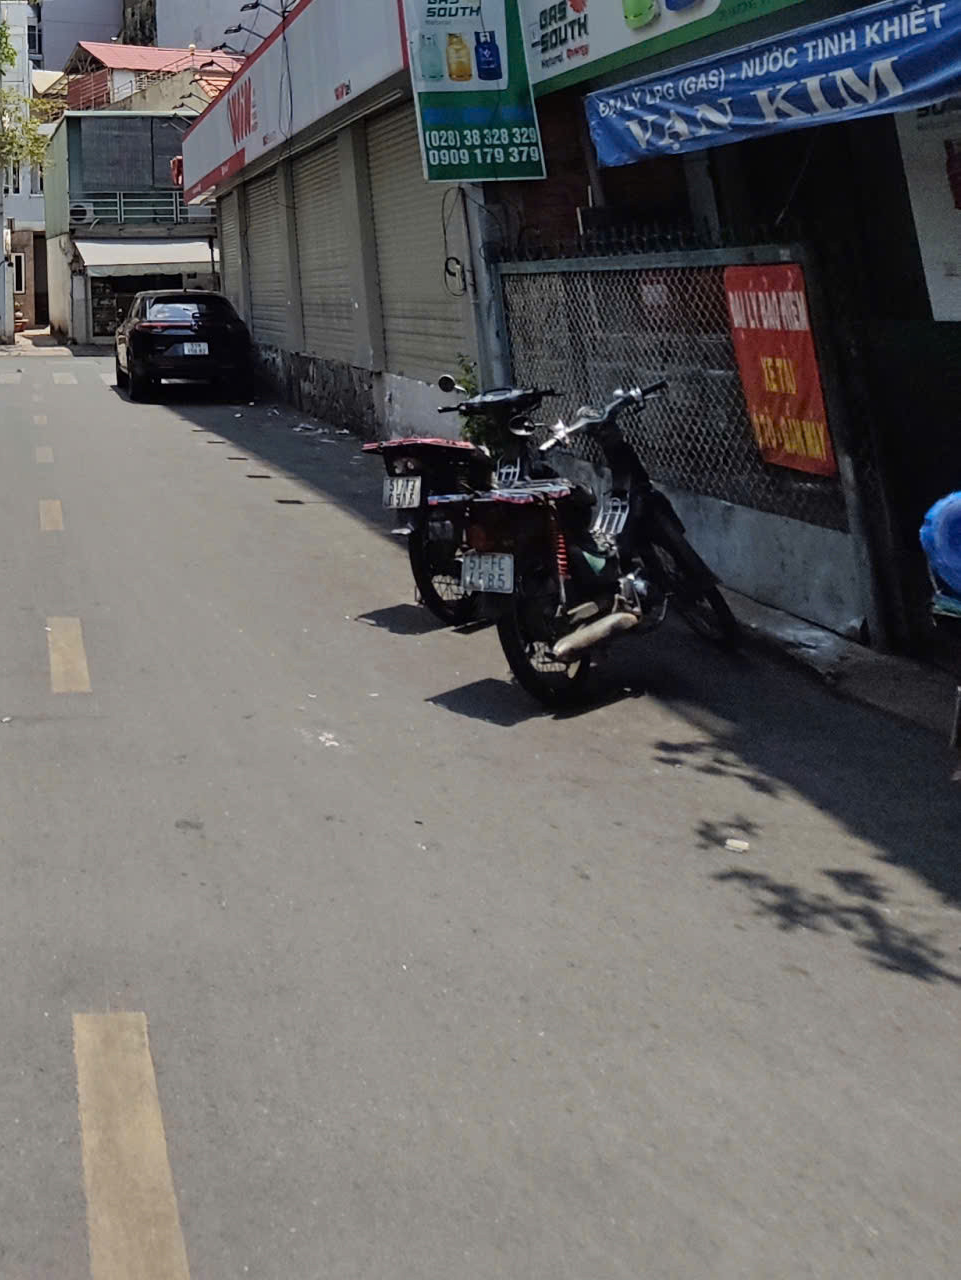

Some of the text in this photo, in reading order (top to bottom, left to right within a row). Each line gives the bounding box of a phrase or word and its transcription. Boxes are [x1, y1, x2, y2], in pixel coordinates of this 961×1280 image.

[426, 6, 481, 18] SOUTH
[540, 0, 568, 30] GAS
[541, 13, 589, 54] SOUTH
[645, 82, 675, 105] LPG
[678, 68, 726, 101] (GAS)
[741, 47, 798, 81] NƯỚC
[803, 30, 857, 64] TINH
[865, 0, 946, 47] KHIẾT
[626, 56, 904, 151] VẠN KIM
[426, 127, 537, 148] (028) 38 328 329
[429, 147, 539, 165] 0909 179 379
